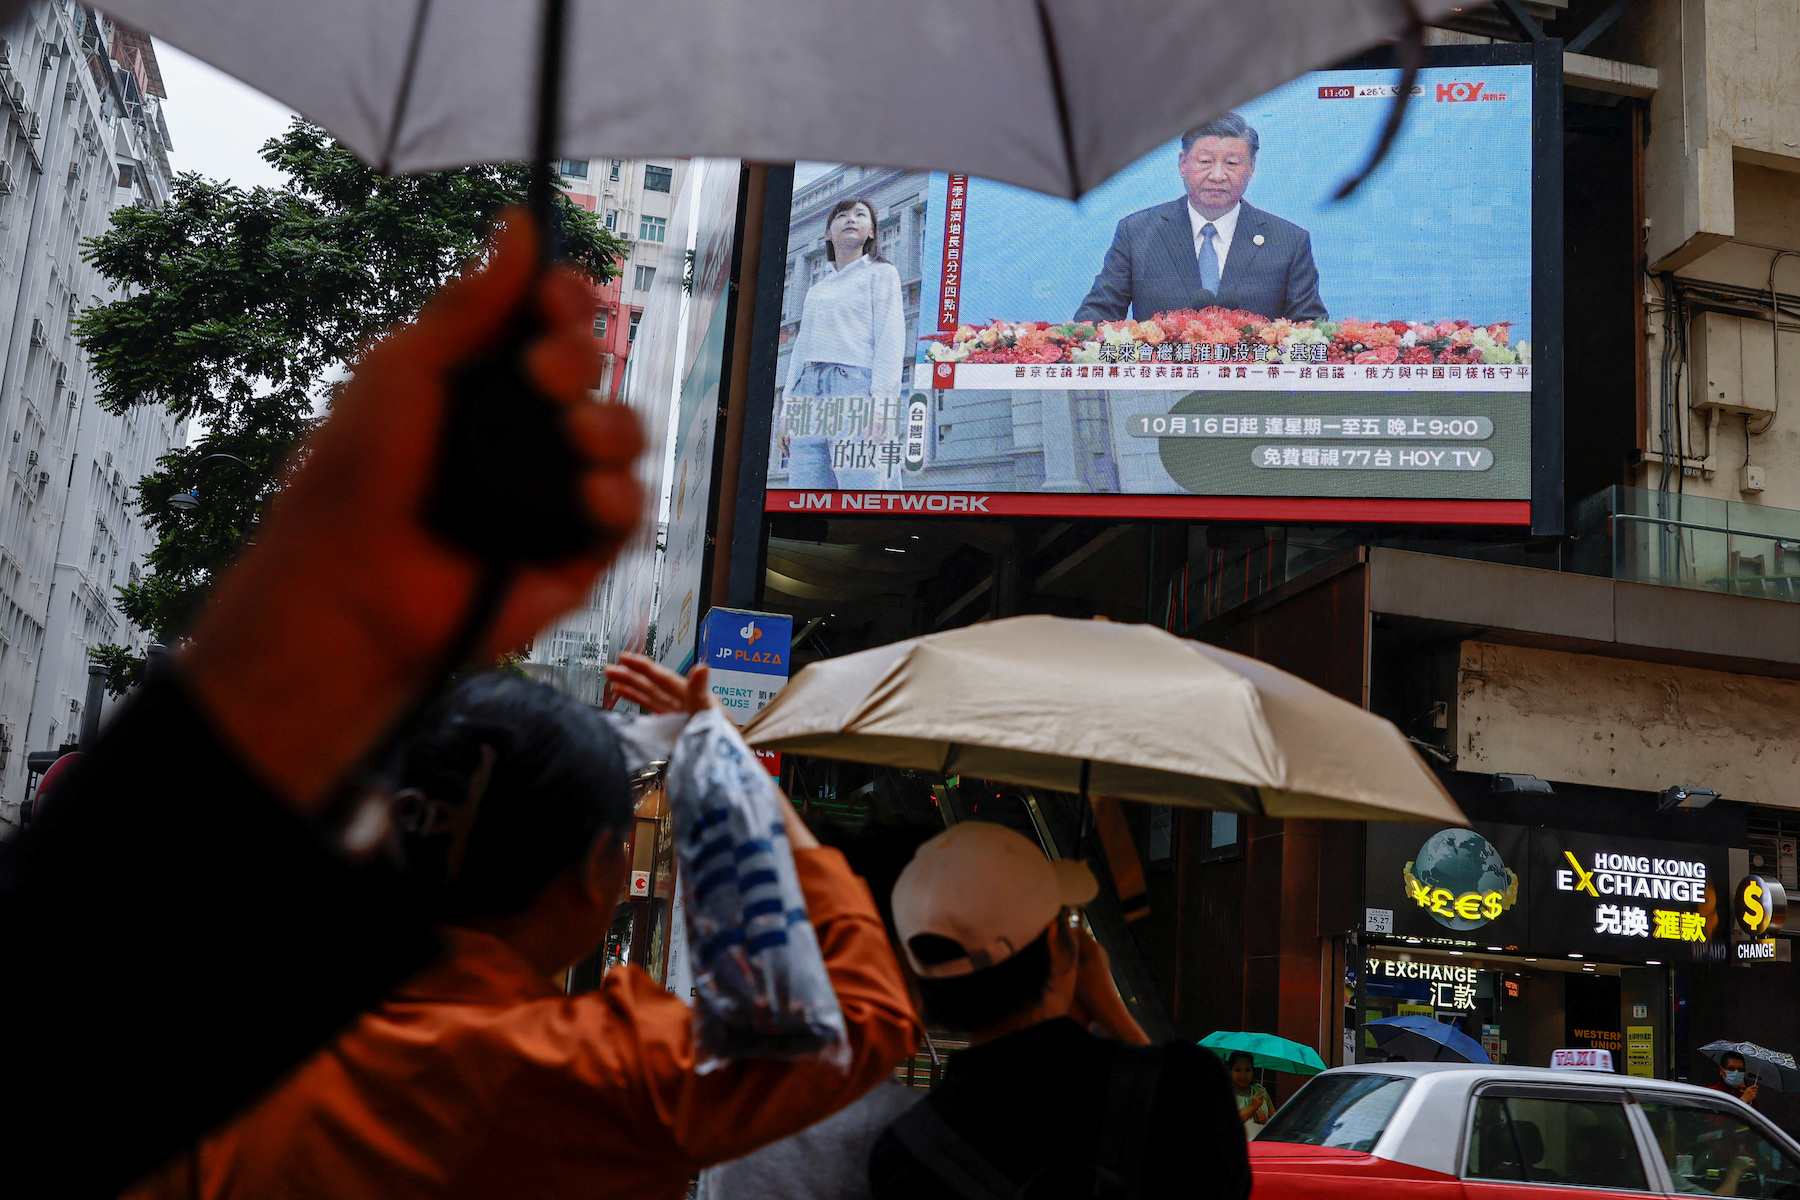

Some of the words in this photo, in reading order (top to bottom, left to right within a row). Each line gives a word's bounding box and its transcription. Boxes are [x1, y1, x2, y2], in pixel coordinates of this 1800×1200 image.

[1323, 88, 1350, 97] 11:00
[1436, 82, 1484, 102] HOY
[1098, 342, 1329, 362] 未來會繼續推動投資、基建
[1140, 416, 1258, 435] 10月16日起
[833, 439, 903, 479] 的故事
[1400, 450, 1445, 467] HOY
[1451, 450, 1481, 467] TV
[788, 493, 832, 509] JM
[842, 494, 990, 512] NETWORK
[716, 647, 732, 659] JP
[735, 649, 782, 664] PLAZA
[712, 686, 753, 698] CINEART
[720, 697, 750, 709] OUSE
[1594, 852, 1650, 873] HONG
[1653, 857, 1706, 879] KONG
[1556, 850, 1706, 903] EXCHANGE
[1742, 880, 1764, 931] $
[1737, 943, 1774, 959] CHANGE
[1385, 960, 1478, 984] EXCHANGE
[1429, 981, 1477, 1010] 汇款
[1574, 1028, 1622, 1041] WESTERN
[1590, 1039, 1622, 1051] UNION
[1555, 1050, 1596, 1066] TAXI
